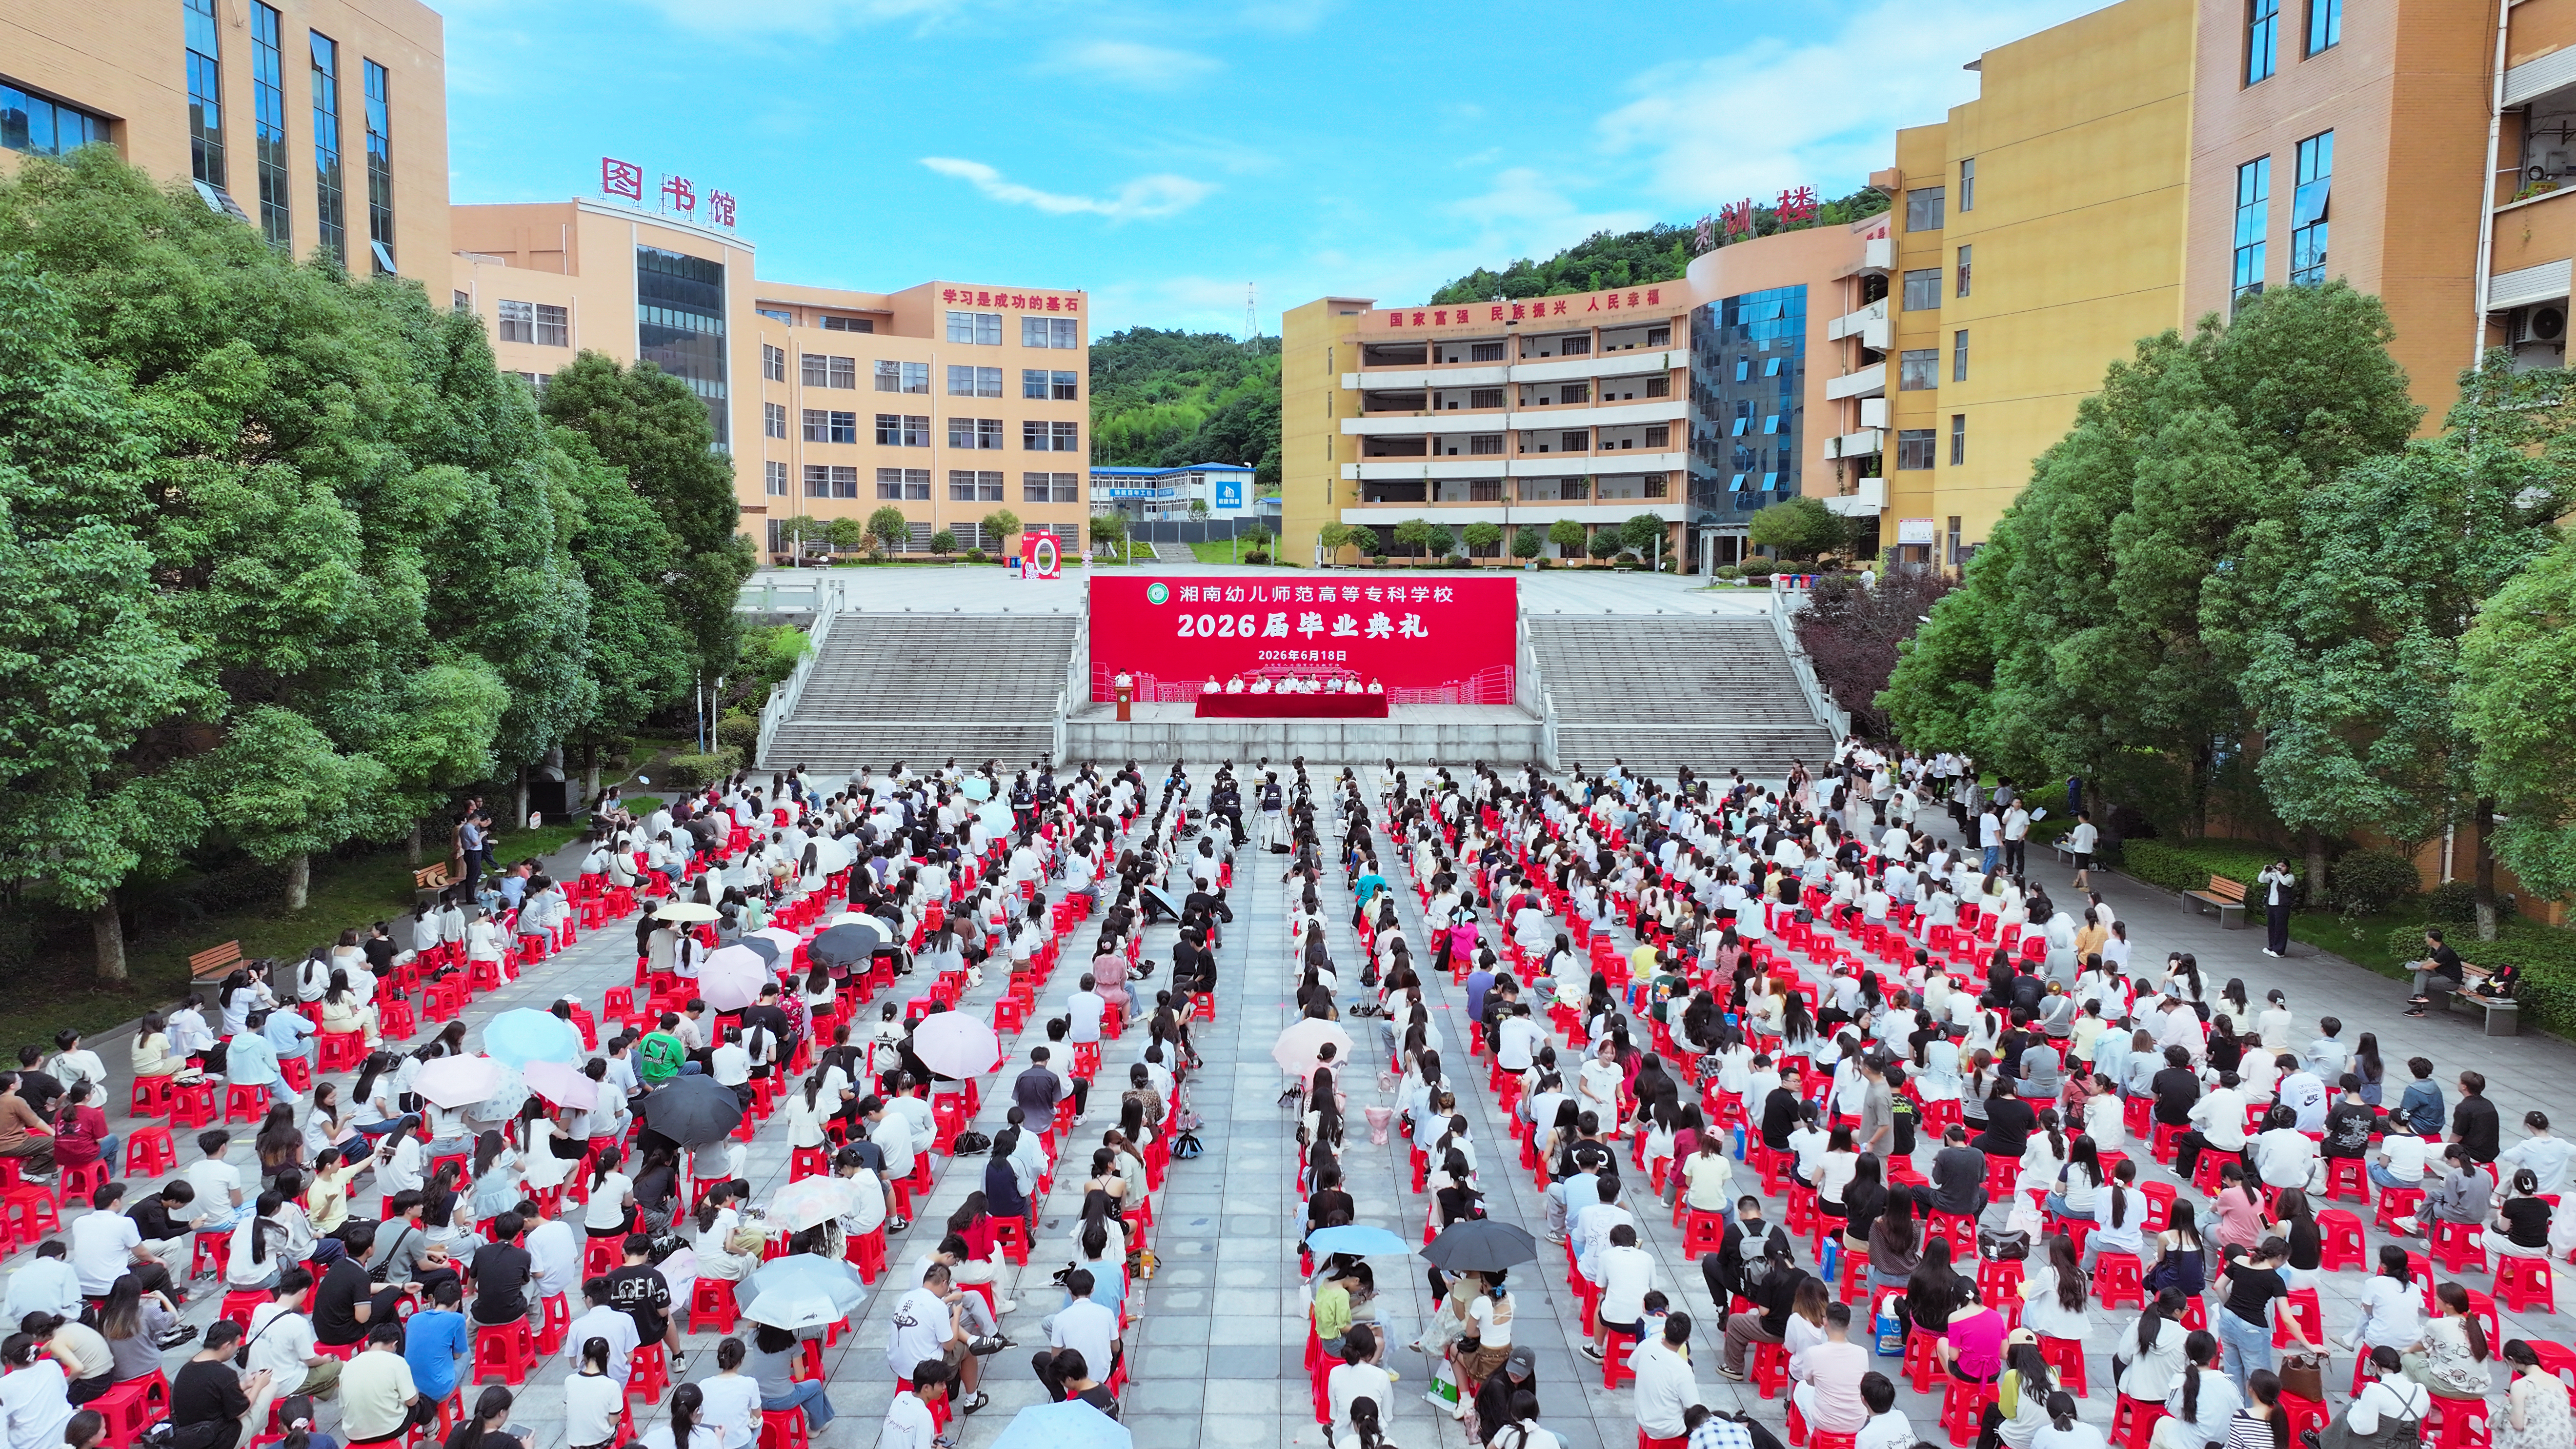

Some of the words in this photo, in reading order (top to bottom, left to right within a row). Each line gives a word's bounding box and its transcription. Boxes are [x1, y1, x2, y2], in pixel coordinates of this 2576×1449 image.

[603, 157, 735, 226] 图书馆
[1694, 186, 1817, 251] 实训楼
[943, 289, 1079, 311] 学习是成功的基石
[1390, 310, 1469, 327] 国家富强
[1491, 301, 1567, 321] 民族振兴
[1587, 289, 1659, 311] 人民幸福
[1179, 586, 1453, 603] 湘南幼儿师范高等专科学校
[1177, 612, 1429, 640] 2026届毕业典礼
[1258, 649, 1347, 661] 2026年6月18日
